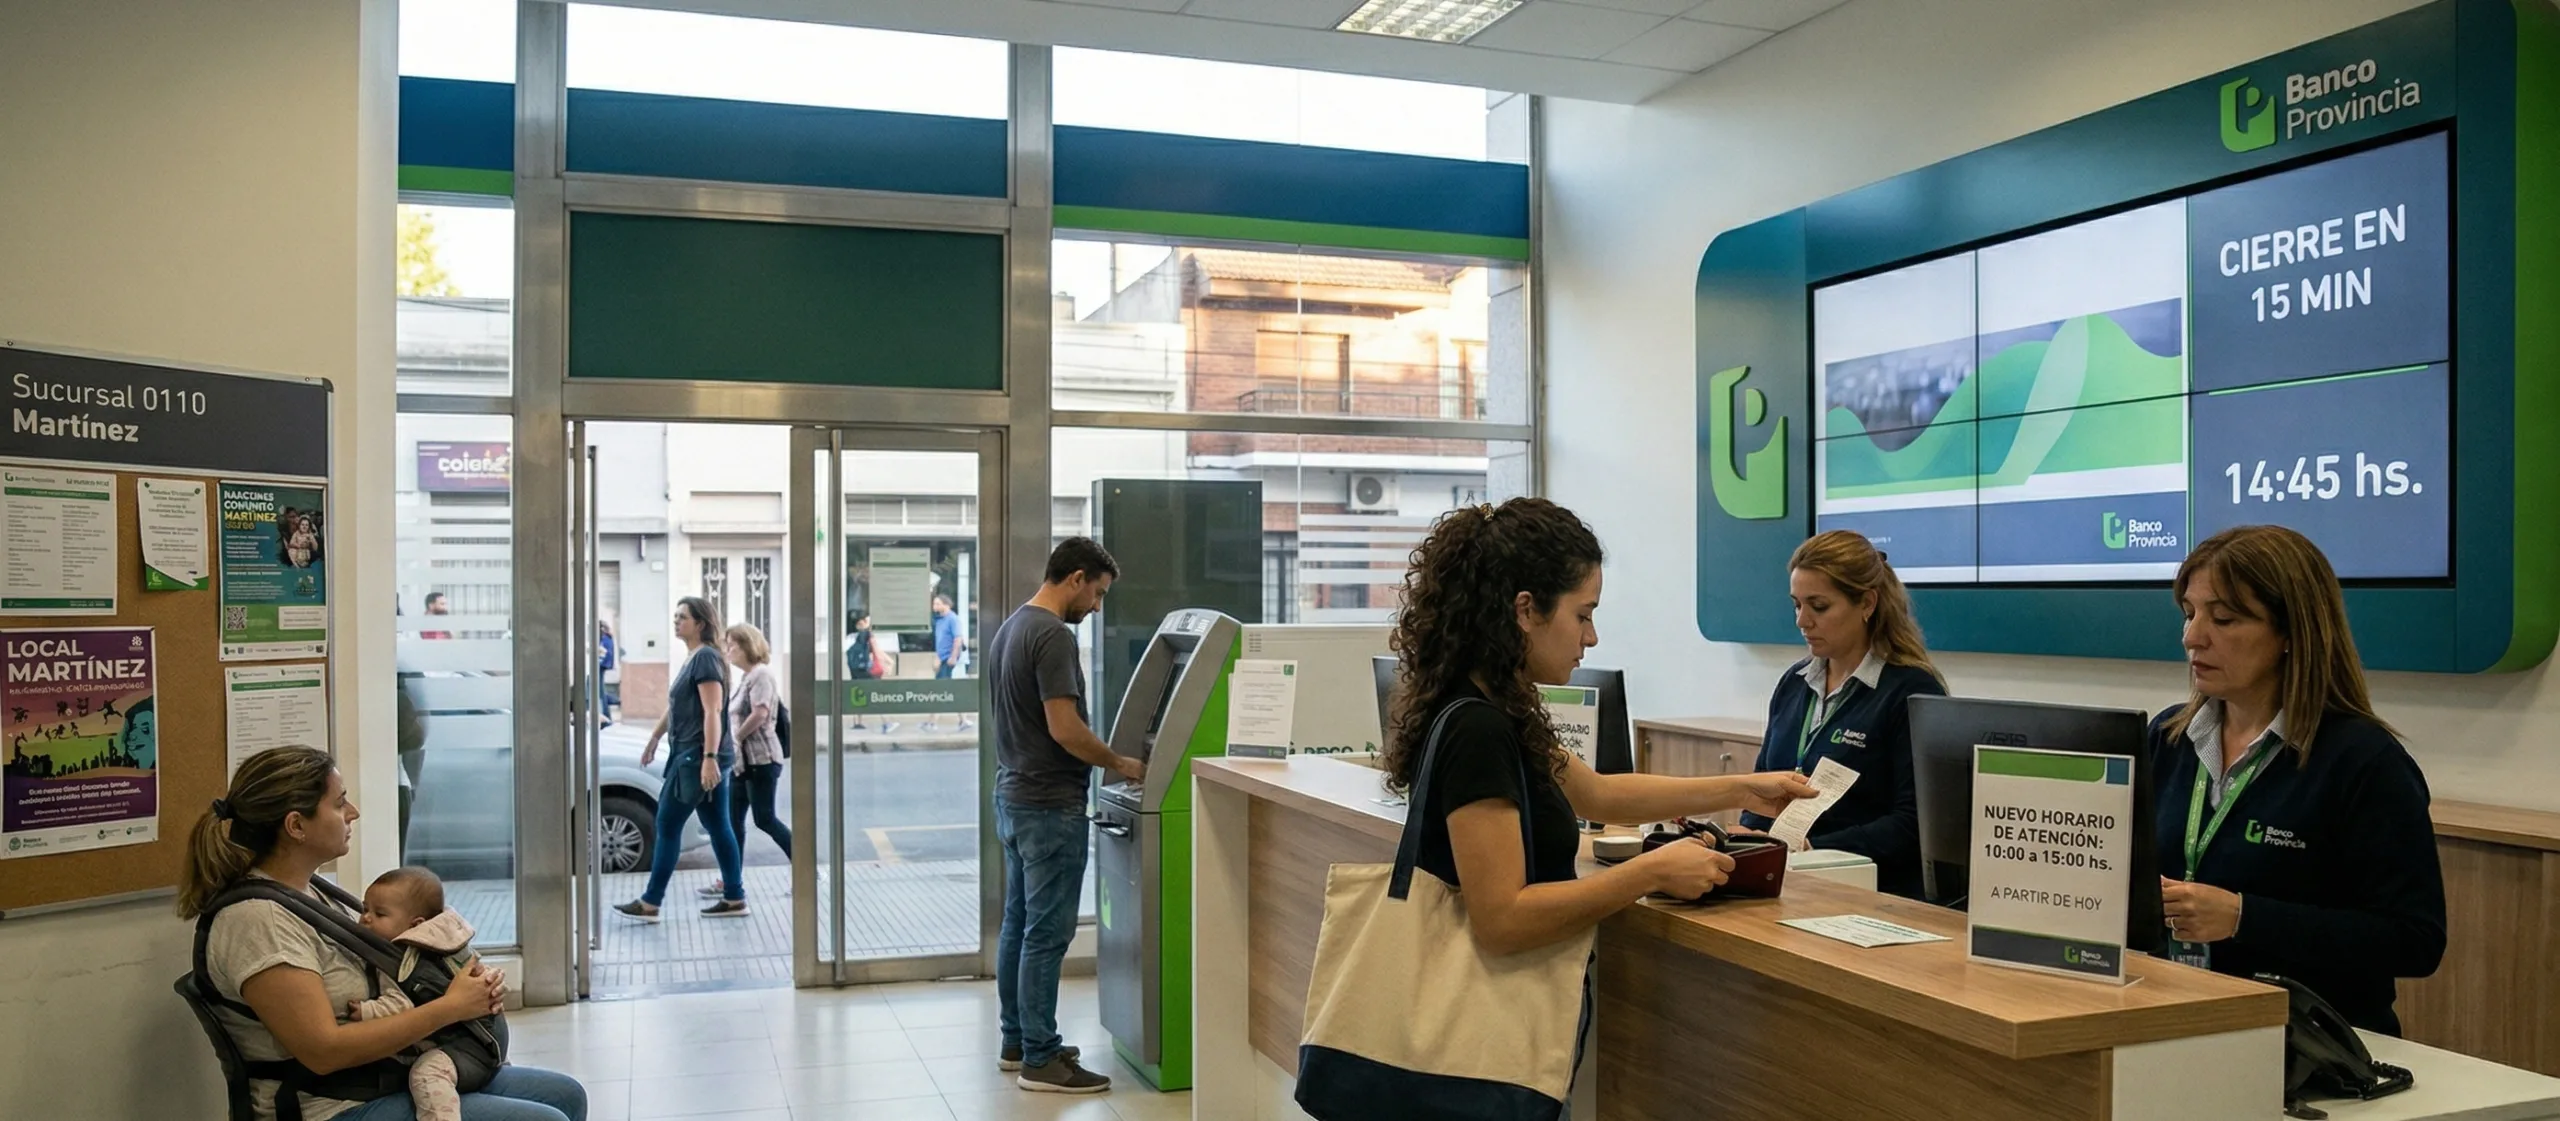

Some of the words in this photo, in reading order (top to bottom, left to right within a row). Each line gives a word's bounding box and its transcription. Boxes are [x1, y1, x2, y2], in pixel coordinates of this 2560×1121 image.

[2286, 59, 2377, 105] Banco
[2287, 78, 2421, 140] Provincia
[2220, 218, 2344, 277] CIERRE
[2354, 204, 2406, 250] EN
[2251, 283, 2290, 322] 15
[2301, 267, 2371, 315] MIN
[13, 373, 135, 409] Sucursal
[143, 386, 206, 416] 0110
[13, 408, 139, 442] Martínez
[2225, 454, 2340, 505] 14:45
[2356, 452, 2423, 497] hs.
[2128, 519, 2163, 533] Banco
[2128, 532, 2178, 548] Provincia
[8, 639, 84, 658] LOCAL
[8, 656, 146, 683] MARTÍNEZ
[870, 691, 904, 703] Banco
[906, 691, 954, 703] Provincia
[1984, 805, 2037, 822] NUEVO
[2041, 809, 2115, 830] HORARIO
[1994, 825, 2014, 840] DE
[2018, 827, 2104, 849] ATENCIÓN:
[1984, 844, 2026, 860] 10:00
[2029, 850, 2038, 863] a
[2042, 849, 2085, 867] 15:00
[2089, 853, 2113, 871] hs.
[1991, 886, 2000, 899] A
[2003, 887, 2050, 905] PARTIR
[2053, 893, 2071, 907] DE
[2074, 896, 2103, 911] HOY
